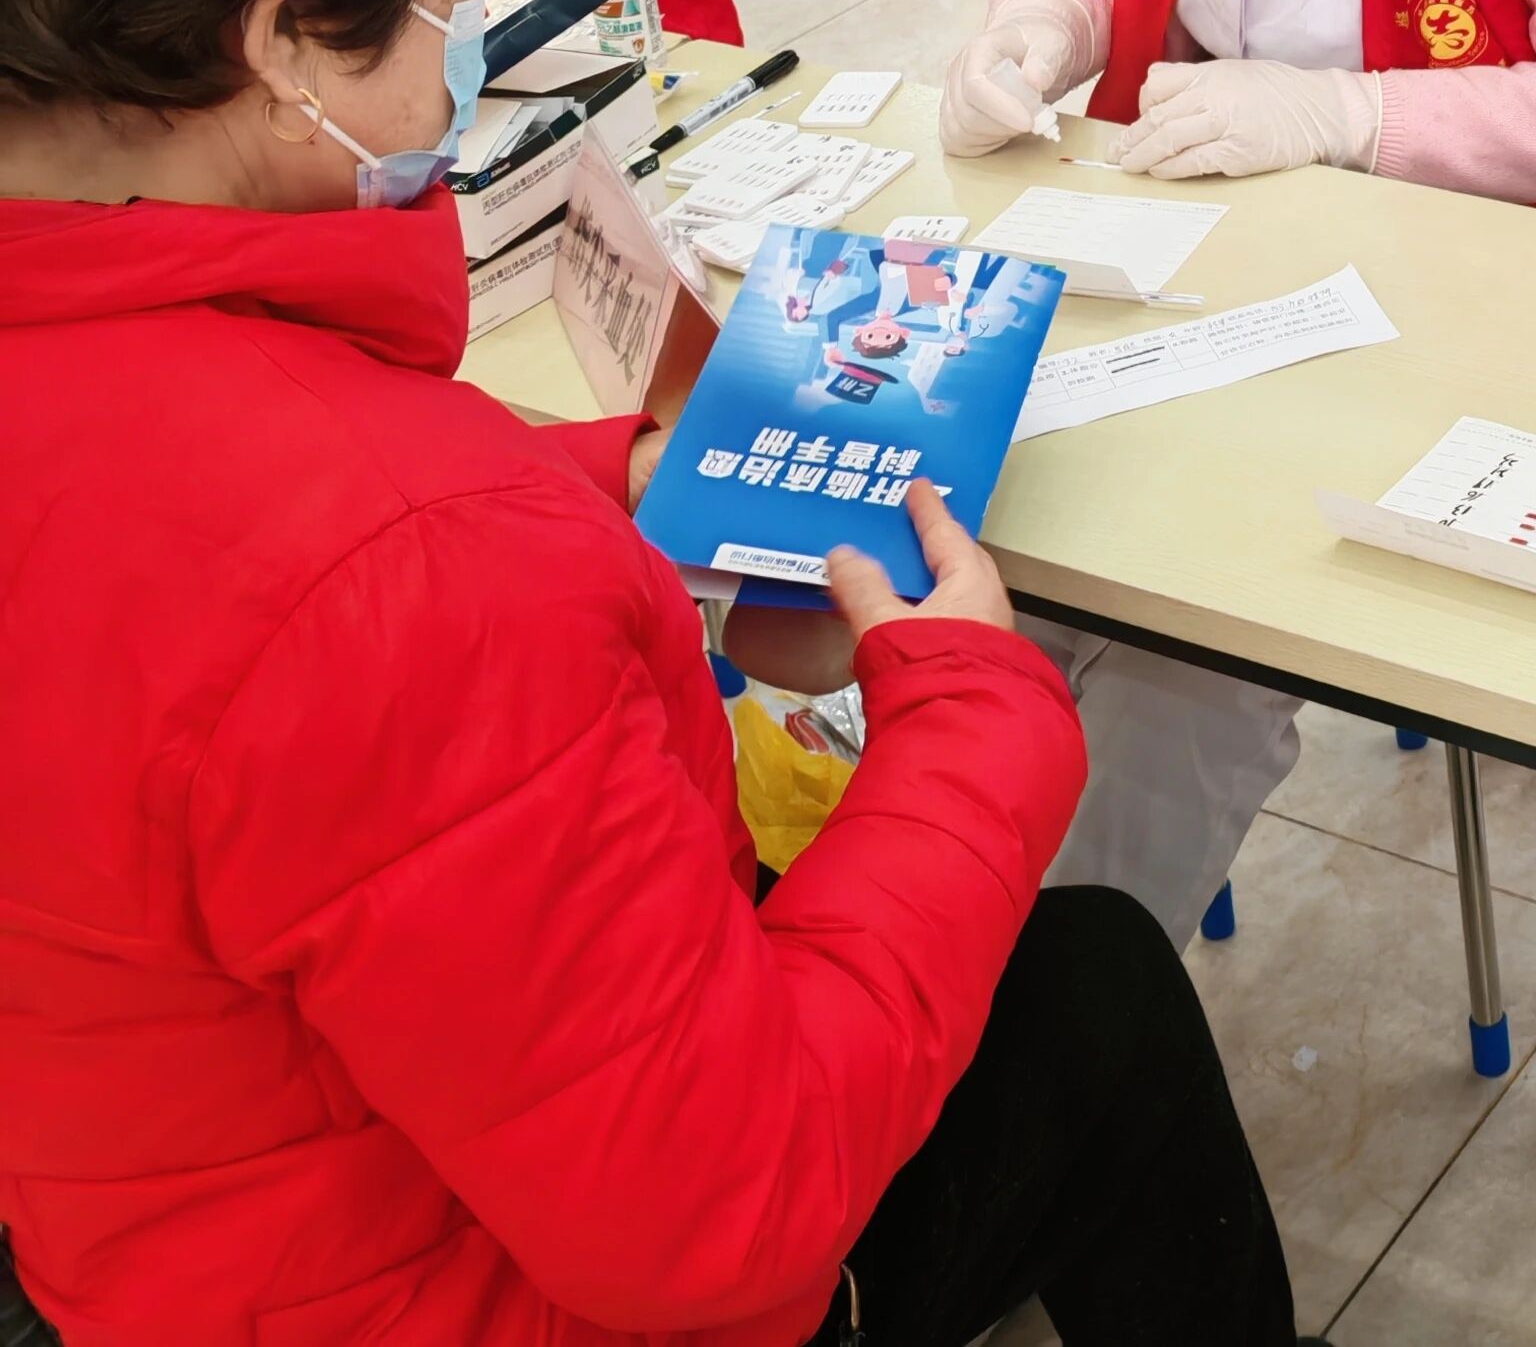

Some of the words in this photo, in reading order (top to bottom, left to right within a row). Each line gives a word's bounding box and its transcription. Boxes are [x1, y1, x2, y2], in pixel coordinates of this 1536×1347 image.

[696, 447, 954, 508] 肝临床治愈
[750, 427, 923, 478] 科普手册
